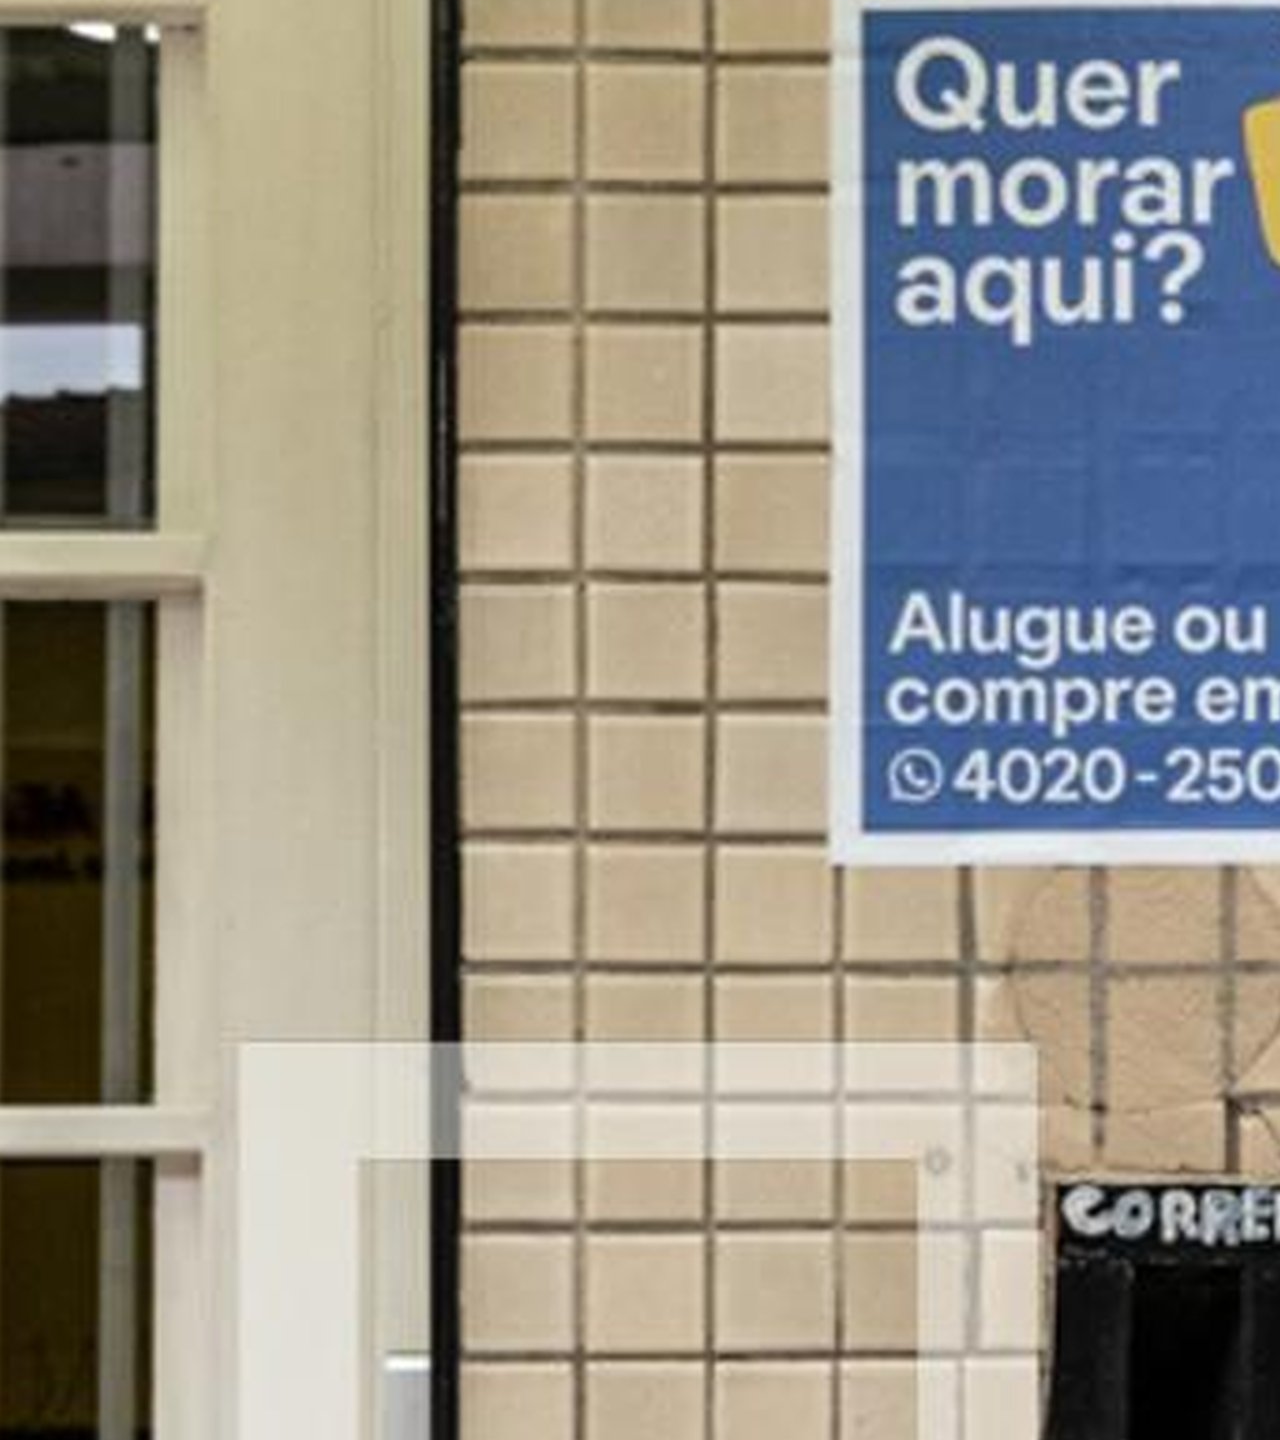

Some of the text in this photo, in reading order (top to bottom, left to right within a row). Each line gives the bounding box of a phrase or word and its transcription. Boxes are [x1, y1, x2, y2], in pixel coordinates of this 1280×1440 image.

[895, 35, 1181, 133] Quer
[897, 158, 1234, 227] morar
[895, 233, 1204, 346] aqui?
[888, 591, 1266, 666] Alugue ou
[887, 674, 1175, 736] compre
